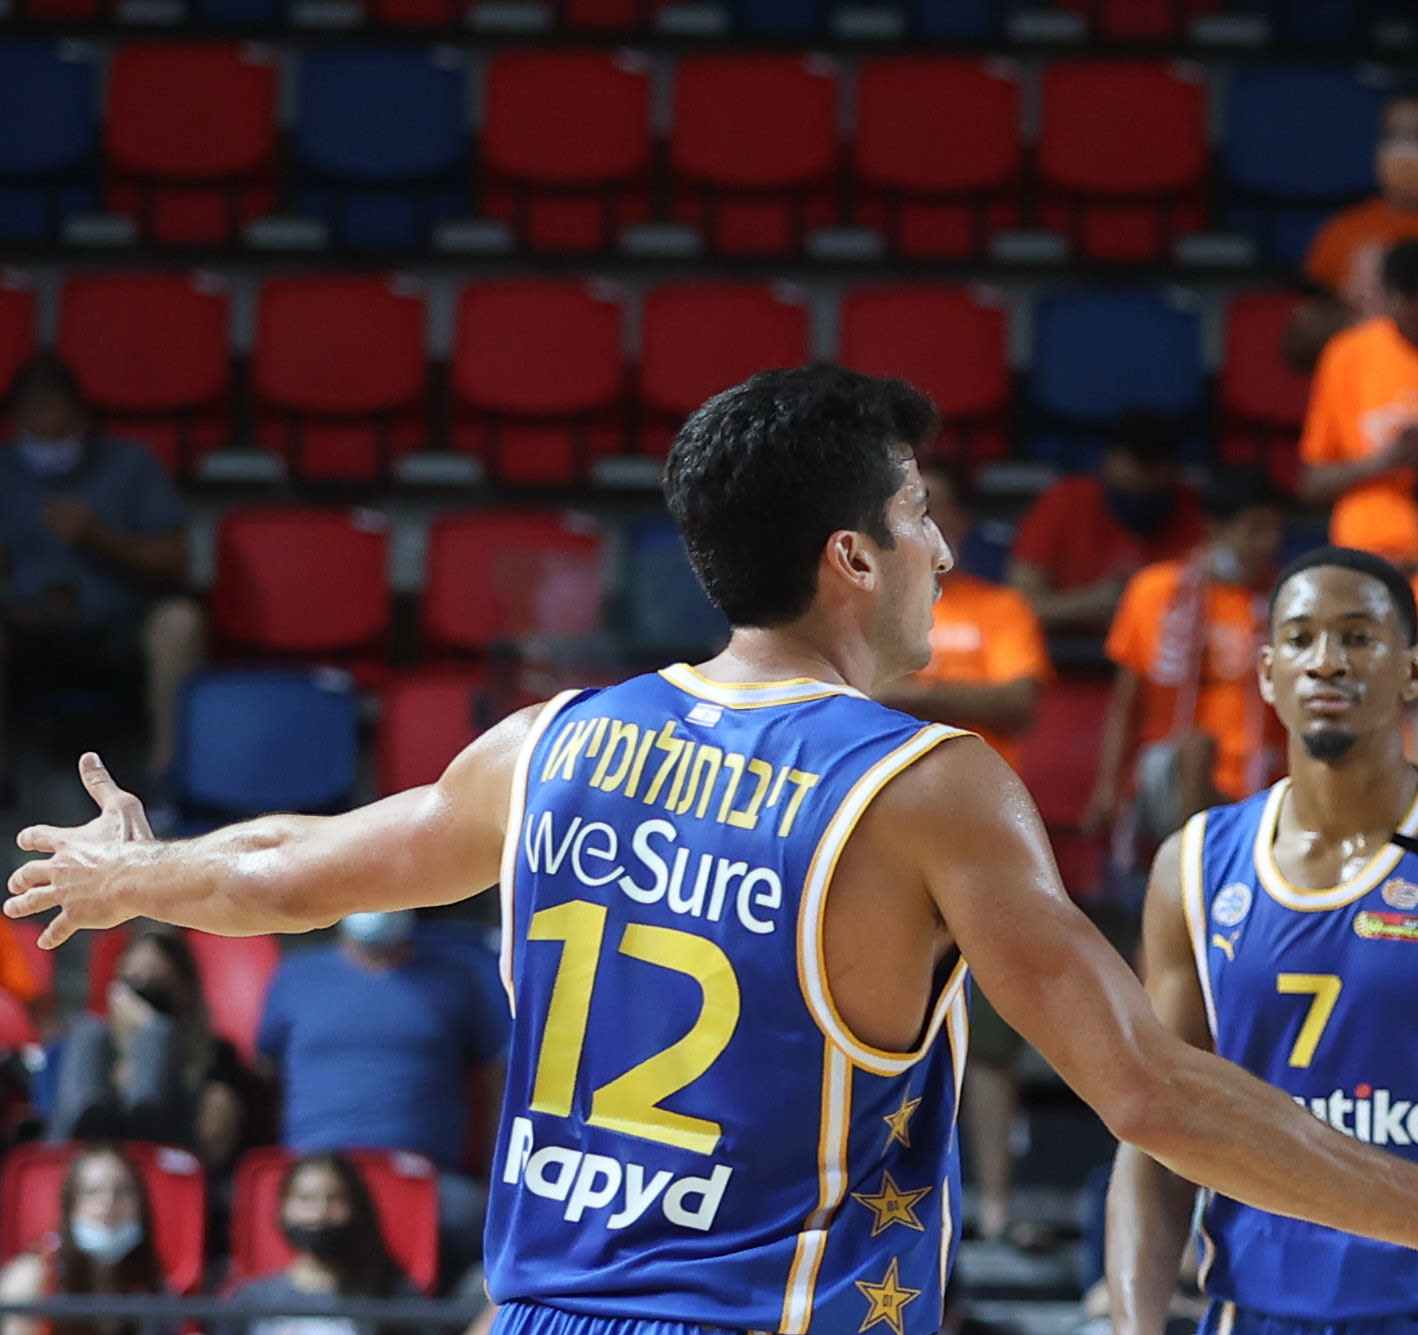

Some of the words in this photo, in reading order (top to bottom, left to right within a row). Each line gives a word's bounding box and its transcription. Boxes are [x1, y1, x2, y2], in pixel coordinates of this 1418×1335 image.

[524, 811, 782, 933] weSure
[526, 900, 741, 1156] 12
[1276, 973, 1342, 1068] 7
